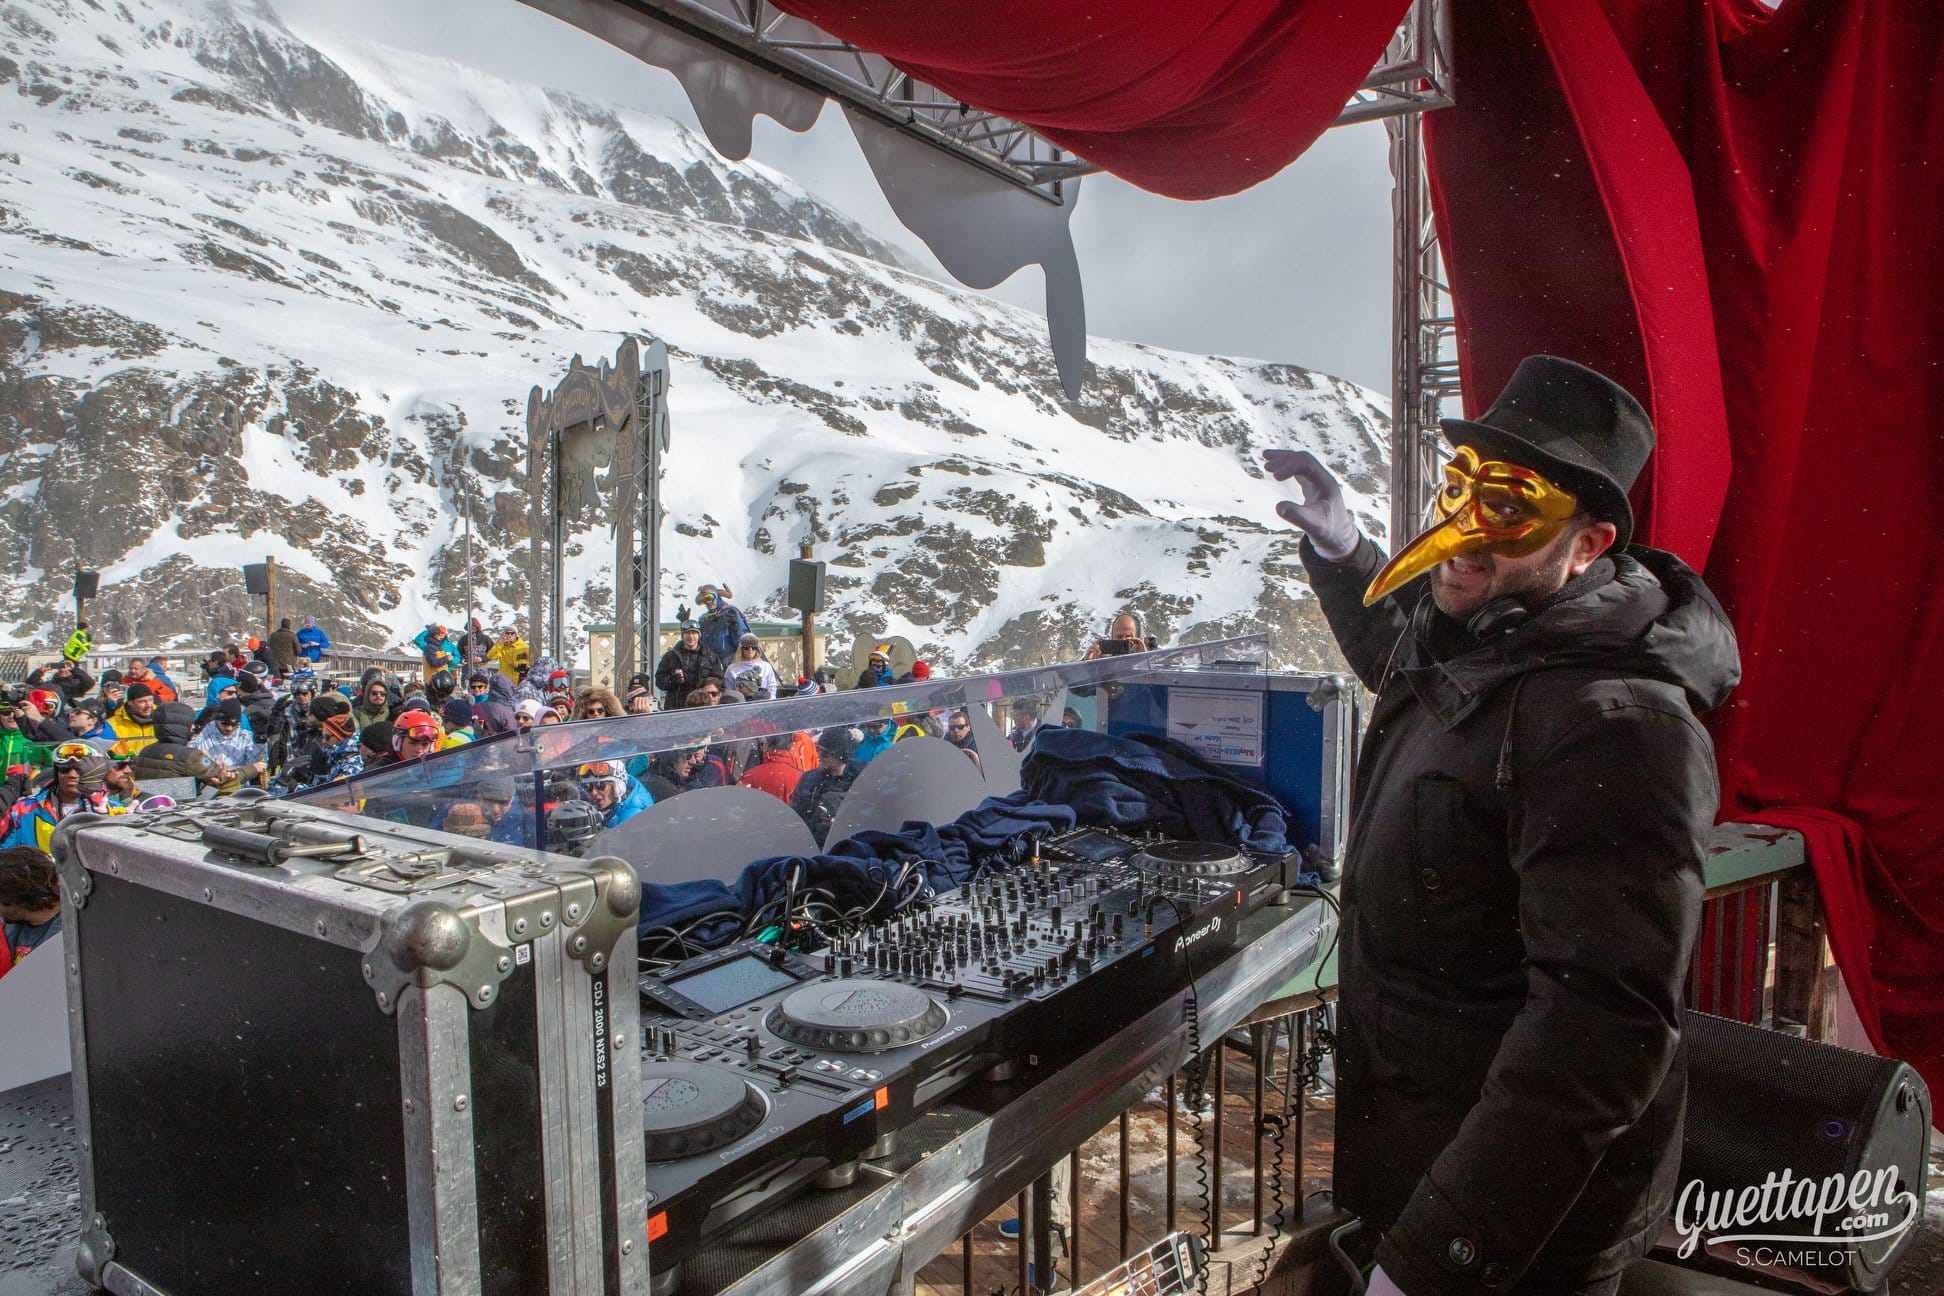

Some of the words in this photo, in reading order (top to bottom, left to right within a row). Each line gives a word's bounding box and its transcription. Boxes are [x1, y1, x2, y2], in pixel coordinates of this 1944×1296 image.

[594, 981, 603, 1007] CDJ
[595, 1009, 604, 1036] 2000
[596, 1038, 606, 1071] NXS2
[597, 1072, 606, 1087] 23
